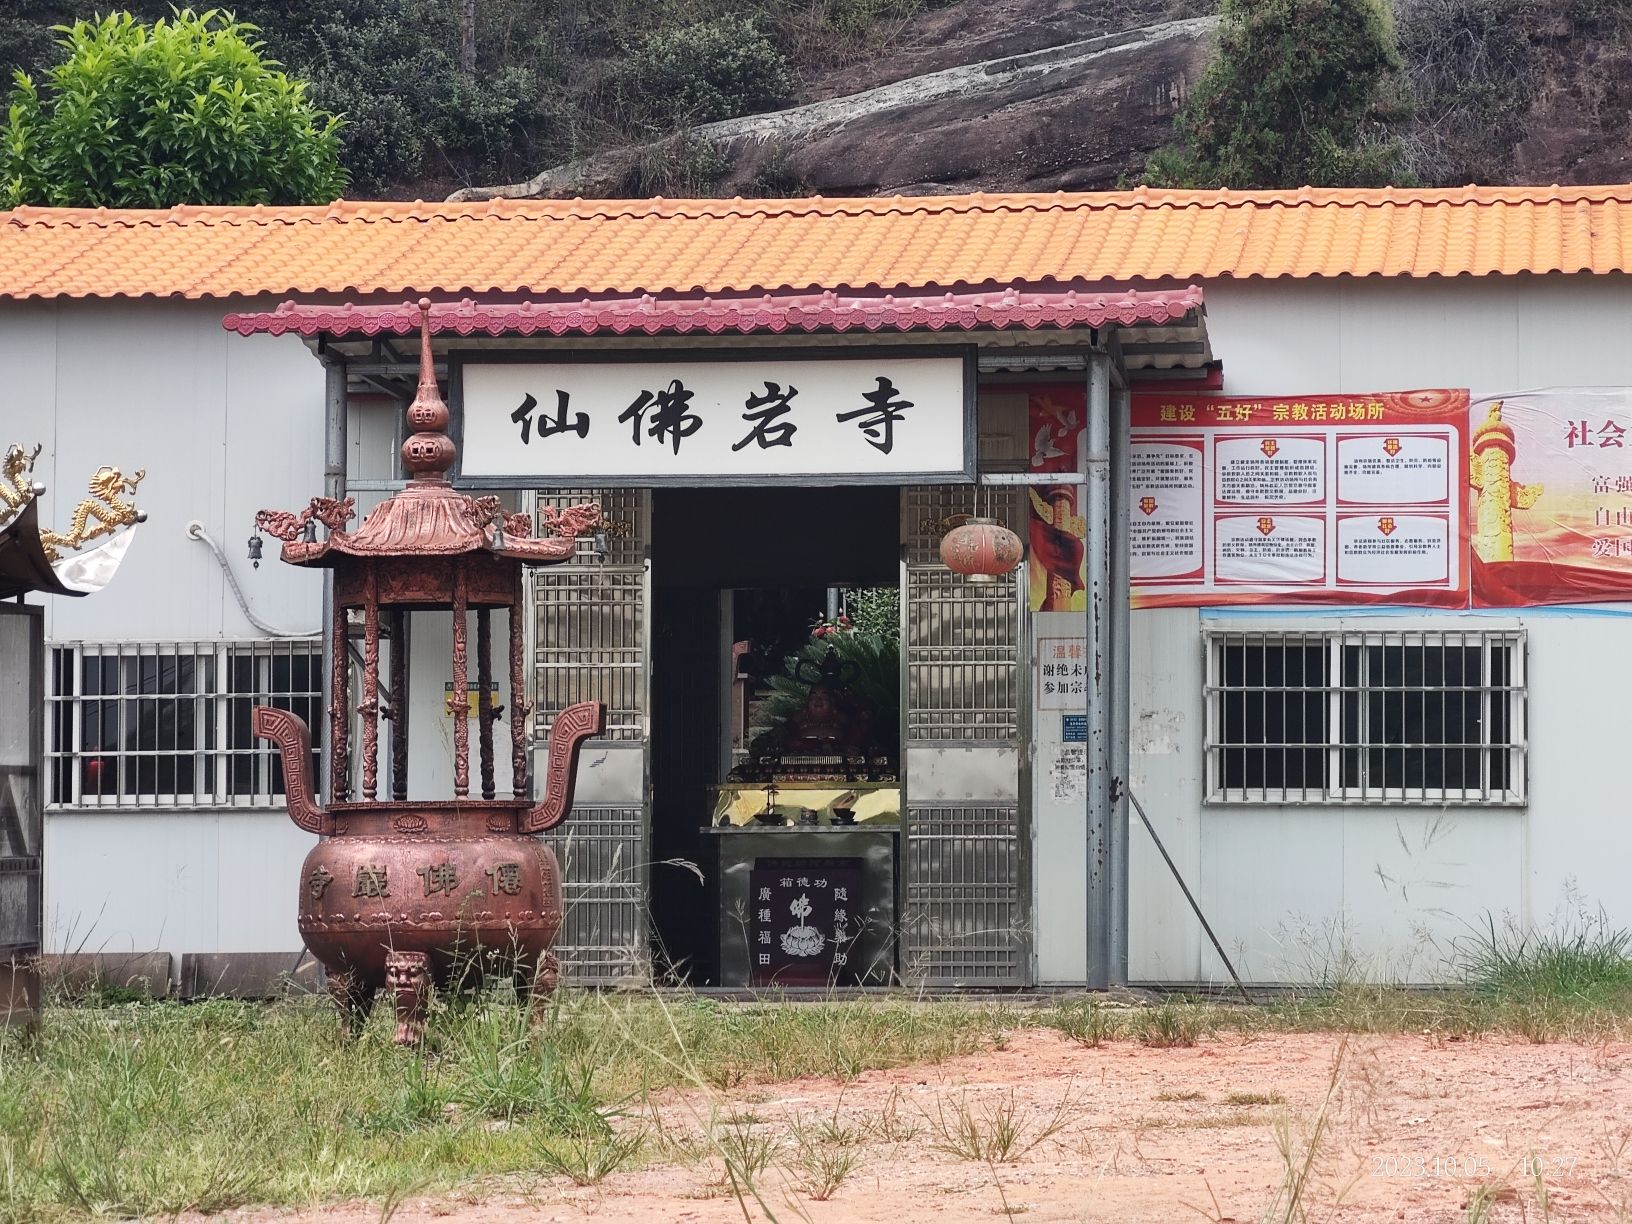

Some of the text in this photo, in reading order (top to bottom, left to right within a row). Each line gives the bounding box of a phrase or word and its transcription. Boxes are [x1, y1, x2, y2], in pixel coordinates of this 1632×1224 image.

[1563, 420, 1632, 448] 社会
[1053, 645, 1087, 659] 温馨
[1043, 664, 1087, 677] 谢绝未
[1044, 681, 1087, 694] 参加宗
